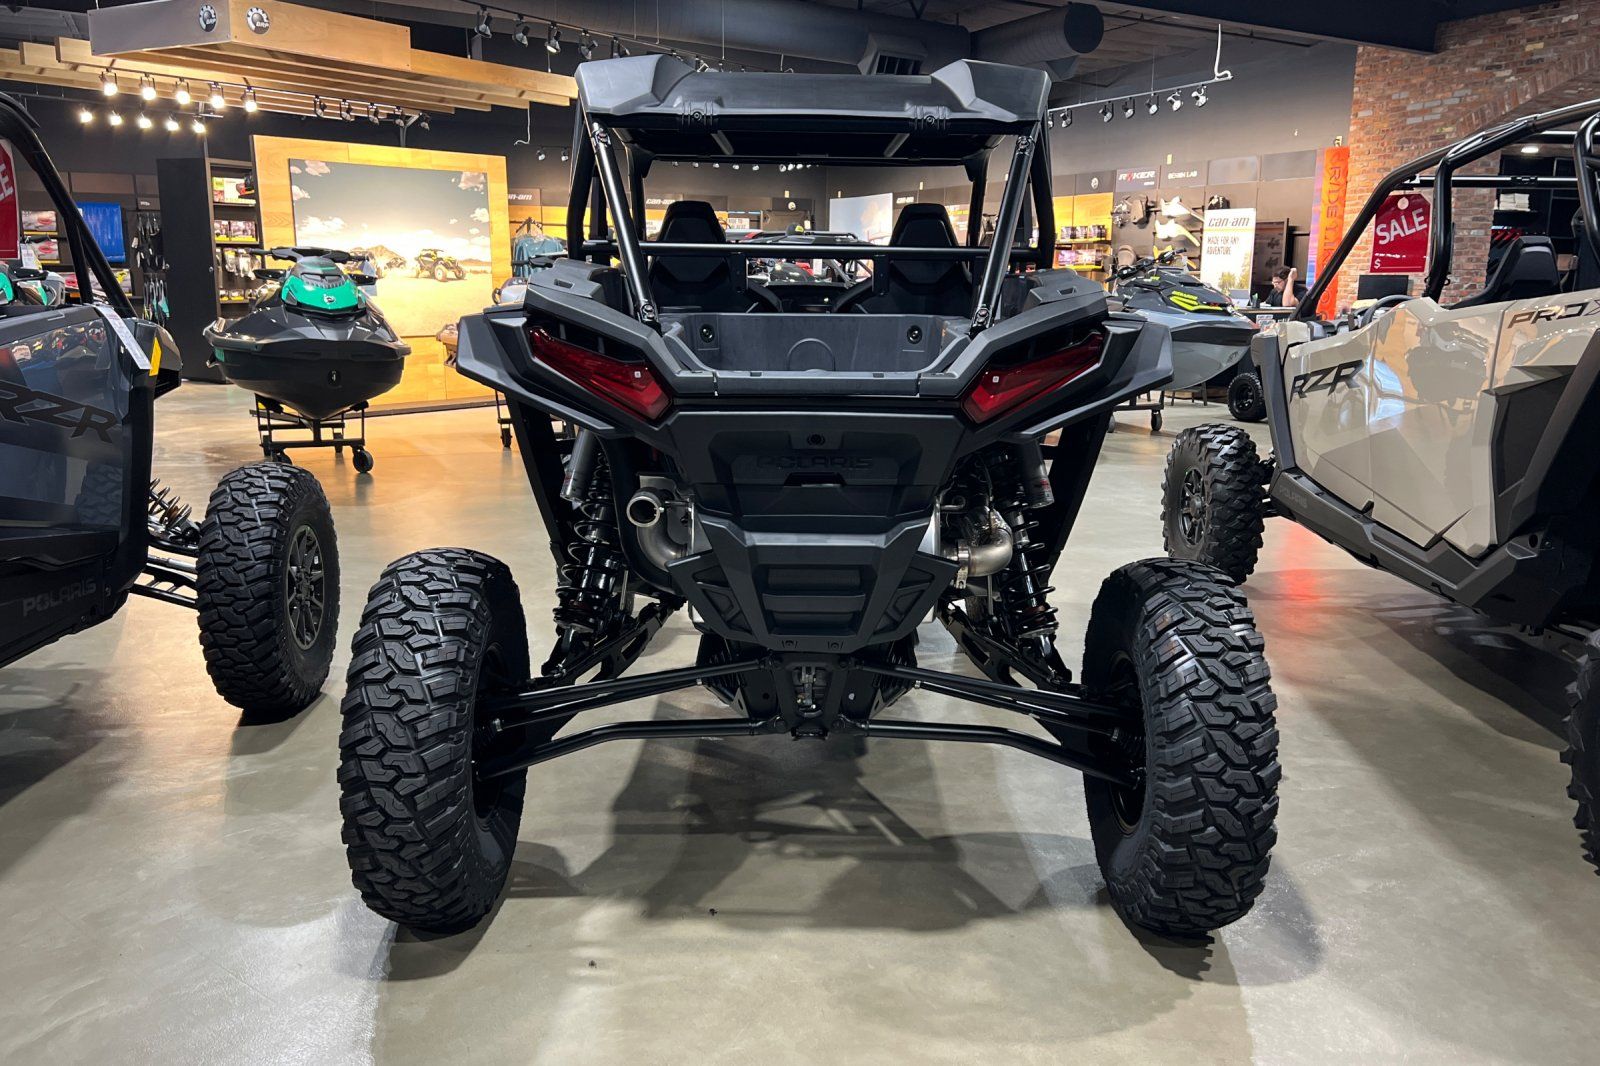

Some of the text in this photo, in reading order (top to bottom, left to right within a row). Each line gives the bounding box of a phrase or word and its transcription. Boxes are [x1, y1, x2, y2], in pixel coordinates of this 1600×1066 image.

[1375, 208, 1428, 245] SALE
[1289, 359, 1365, 404] RZR
[756, 455, 874, 470] POLARIS
[22, 578, 98, 617] POLARIS
